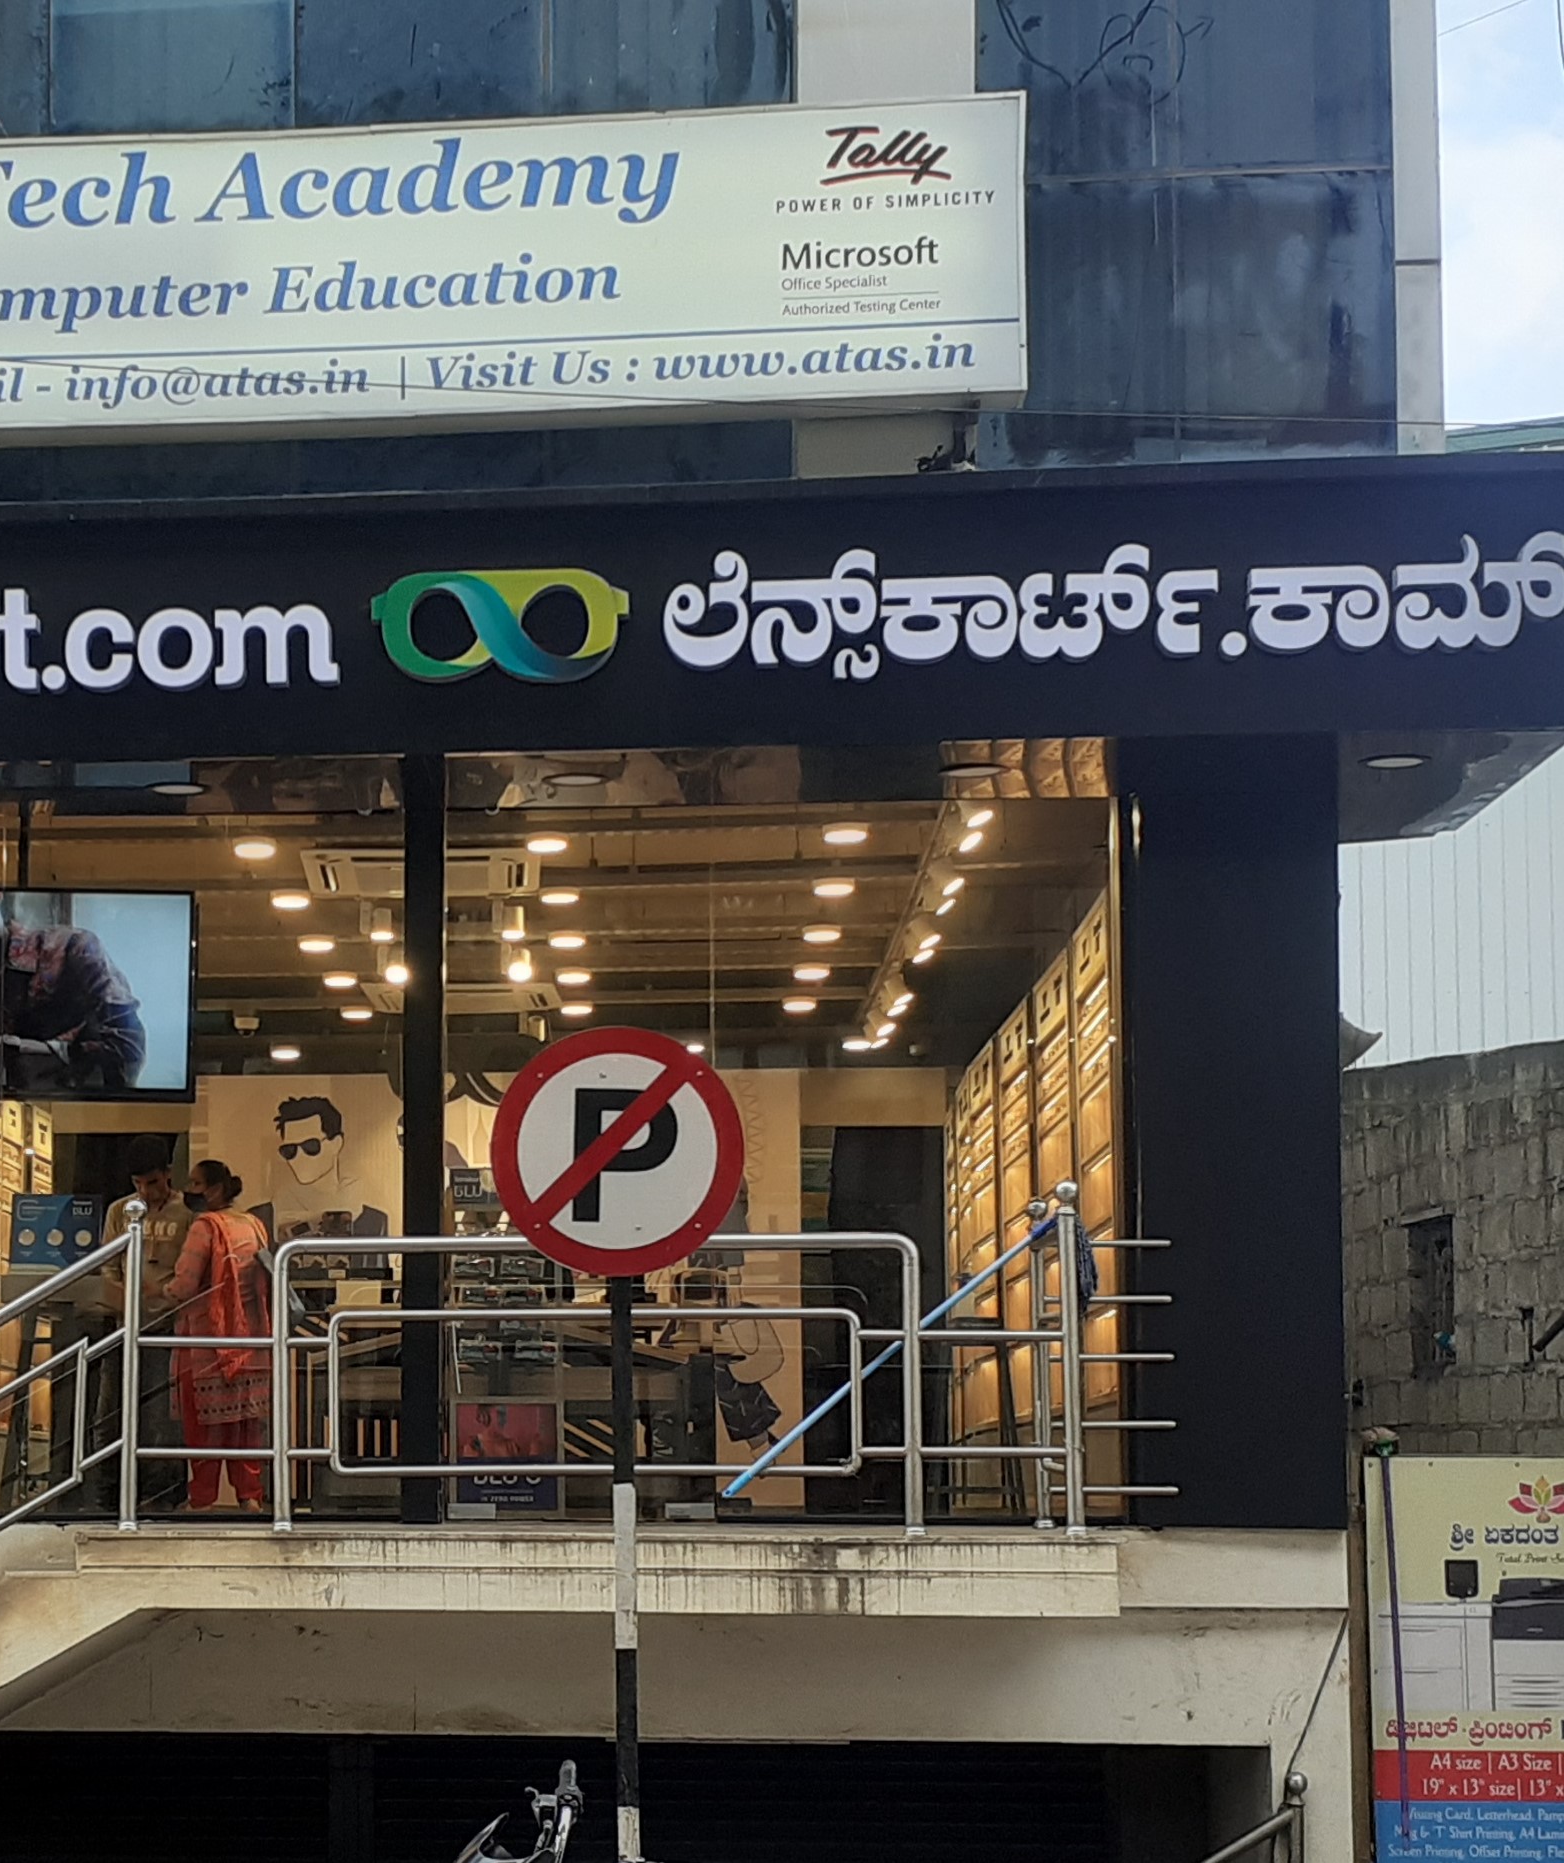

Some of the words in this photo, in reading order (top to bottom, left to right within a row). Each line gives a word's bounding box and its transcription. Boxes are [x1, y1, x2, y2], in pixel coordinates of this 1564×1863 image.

[823, 125, 949, 185] Tally
[194, 137, 680, 224] Academy
[776, 197, 842, 214] POWER
[853, 196, 874, 210] OF
[885, 190, 995, 209] SIMPLICITY
[781, 236, 939, 271] Microsoft
[263, 252, 622, 314] Education
[781, 277, 822, 291] Office
[824, 274, 888, 292] Specialist
[782, 301, 850, 316] Authorized
[854, 300, 897, 315] Testing
[899, 298, 941, 311] Center
[64, 359, 370, 411] info@atas.in
[426, 352, 538, 390] Visit
[552, 350, 611, 386] Us
[654, 333, 975, 381] www.atas.in
[572, 1088, 678, 1222] P
[1449, 1523, 1475, 1551] ಶ್ರೀ
[1485, 1524, 1560, 1545] ಏಕದಂತ
[1430, 1753, 1451, 1770] A4
[1455, 1755, 1482, 1771] size
[1498, 1754, 1519, 1770] A3
[1523, 1754, 1552, 1771] Size
